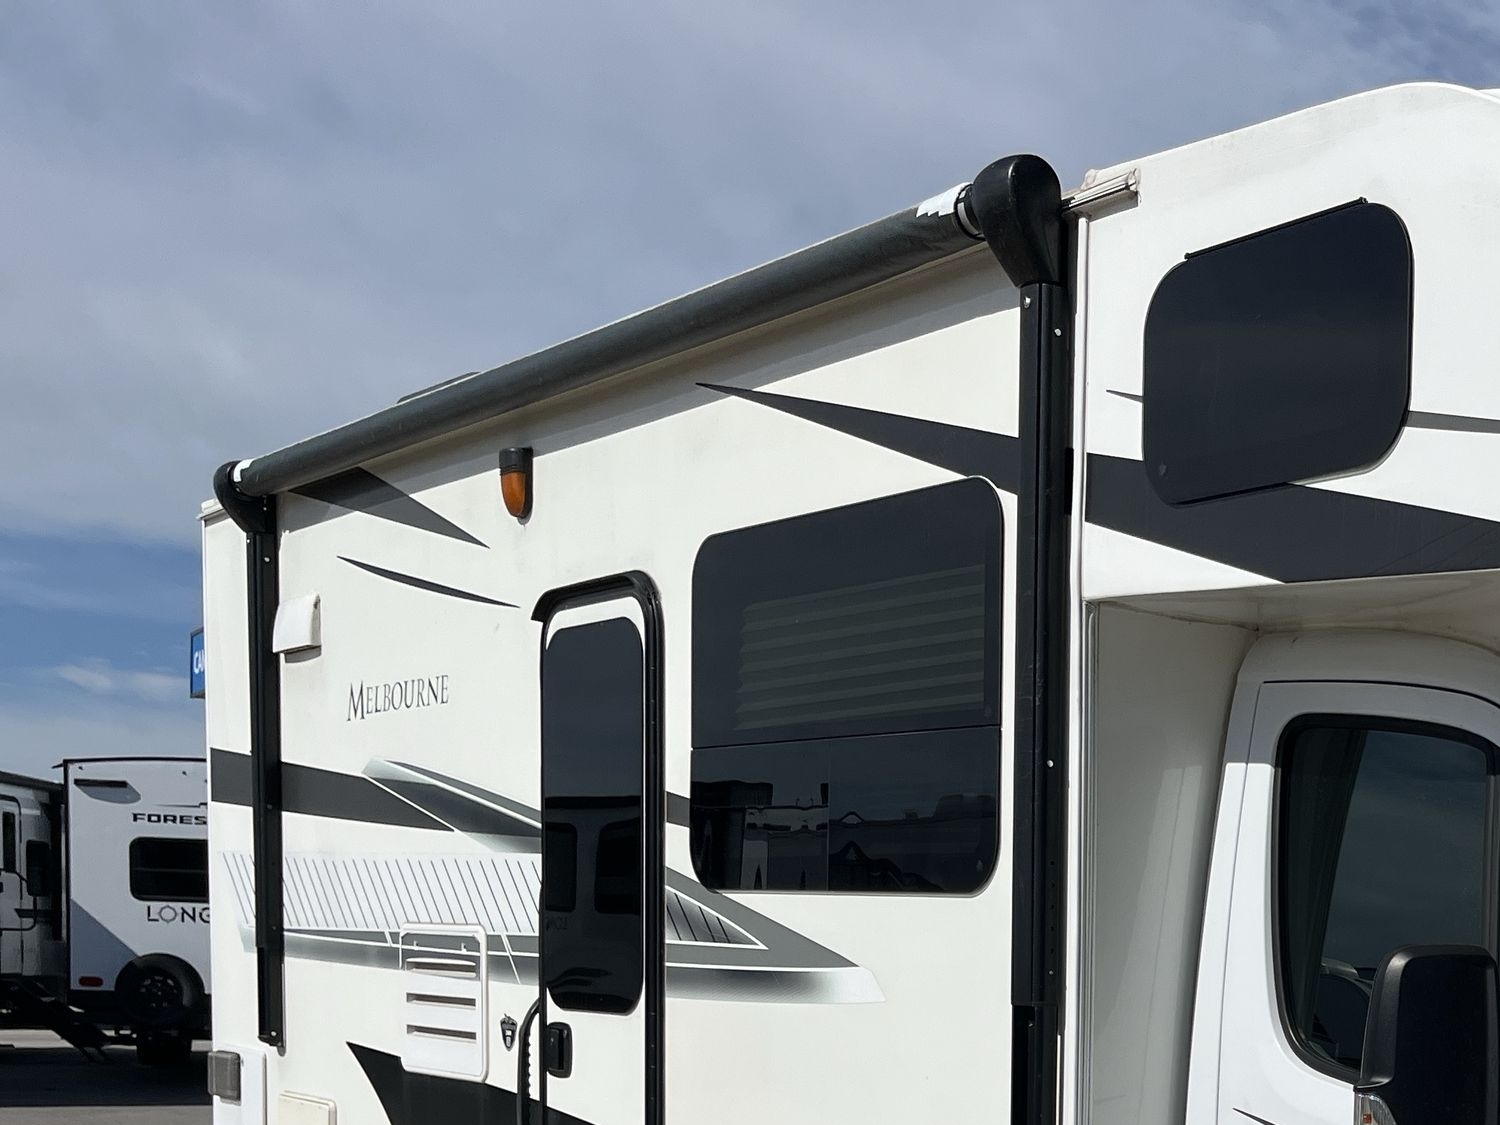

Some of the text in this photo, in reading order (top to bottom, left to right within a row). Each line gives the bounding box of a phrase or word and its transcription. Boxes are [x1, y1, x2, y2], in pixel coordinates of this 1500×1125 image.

[193, 650, 206, 675] CA
[346, 675, 449, 721] MELBOURNE
[132, 812, 207, 825] FORES
